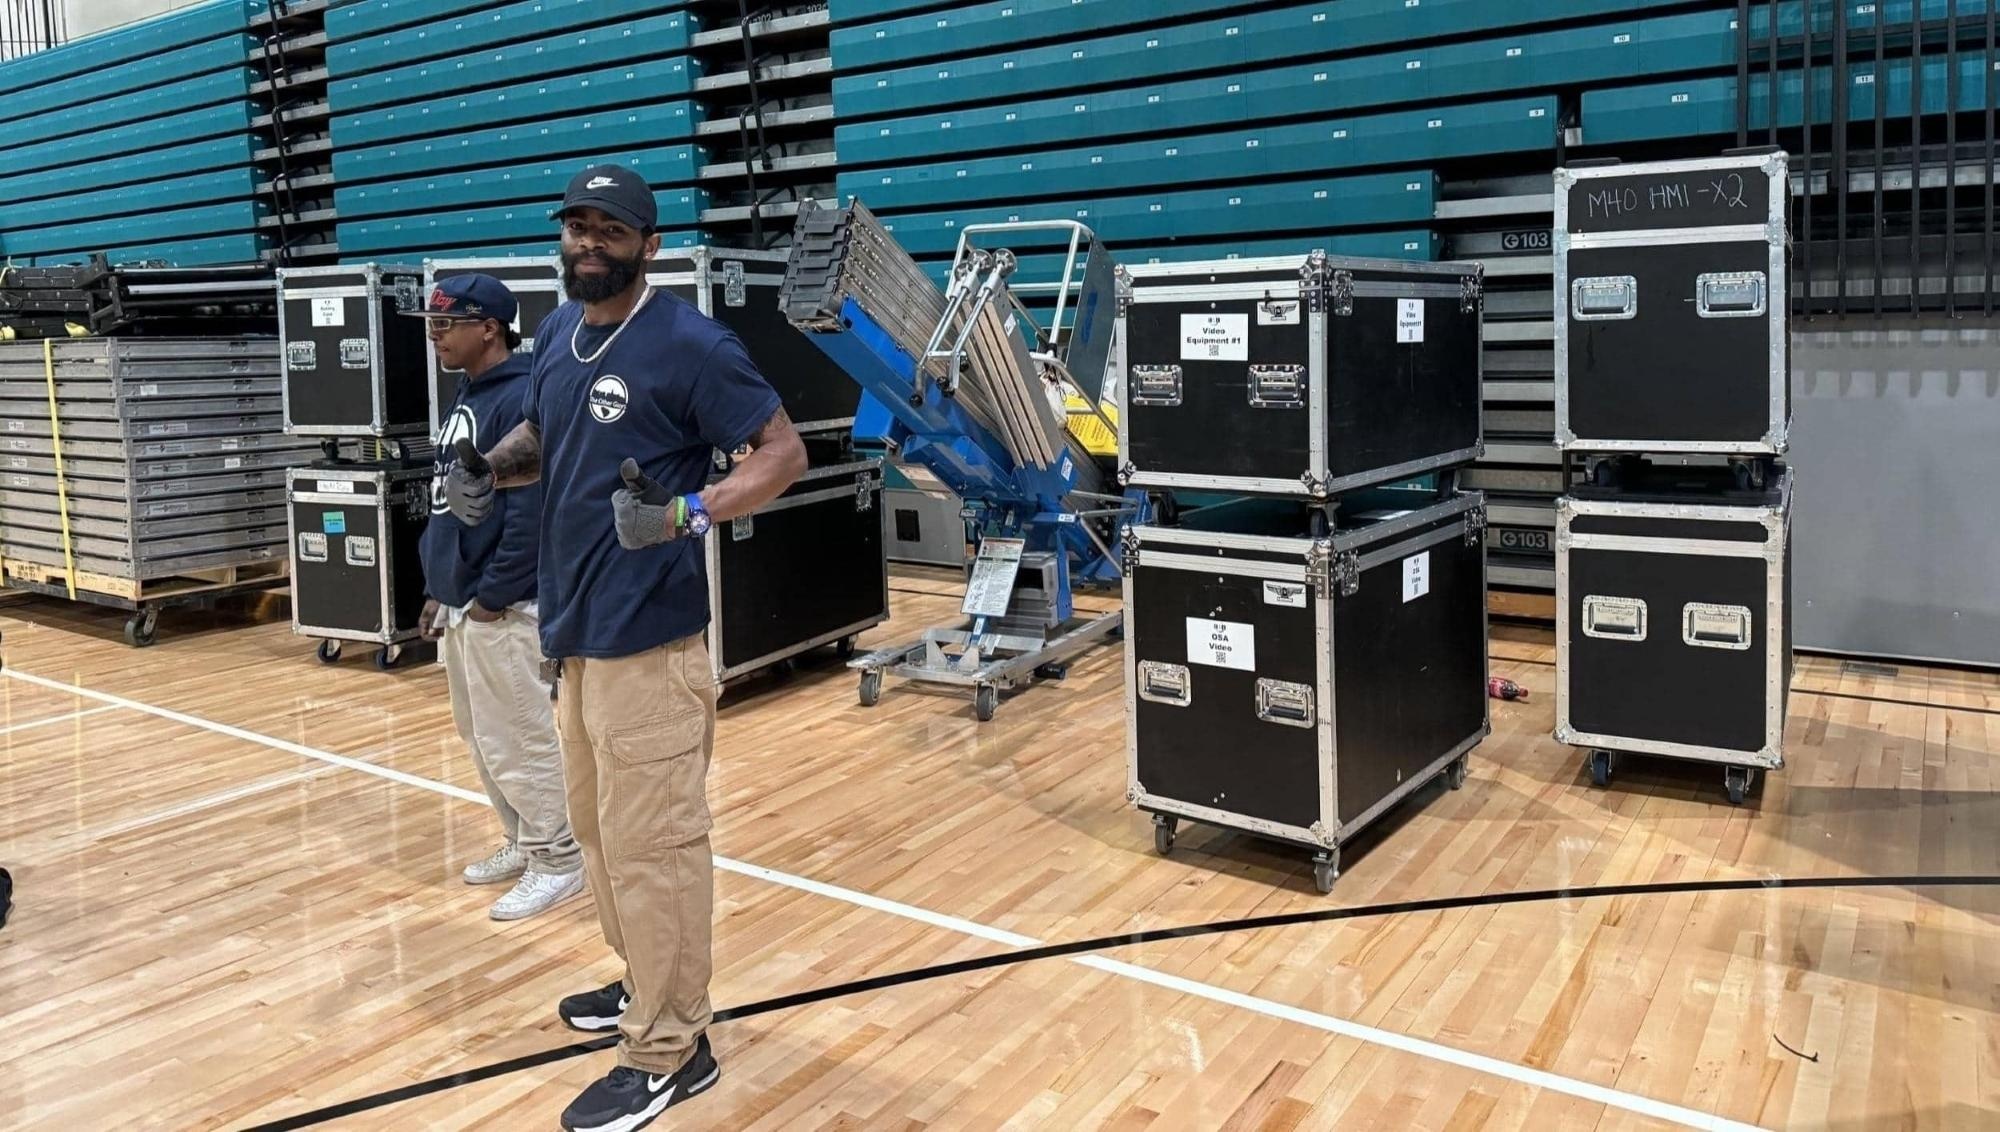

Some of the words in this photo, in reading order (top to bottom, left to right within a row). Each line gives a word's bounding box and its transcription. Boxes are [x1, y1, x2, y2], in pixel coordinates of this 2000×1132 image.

[1588, 187, 1638, 218] M40
[1520, 232, 1549, 248] 103
[1202, 327, 1226, 335] Video
[1186, 336, 1229, 345] Equipment
[1517, 532, 1546, 548] 103
[1211, 633, 1229, 642] OSA
[1208, 642, 1233, 652] Video
